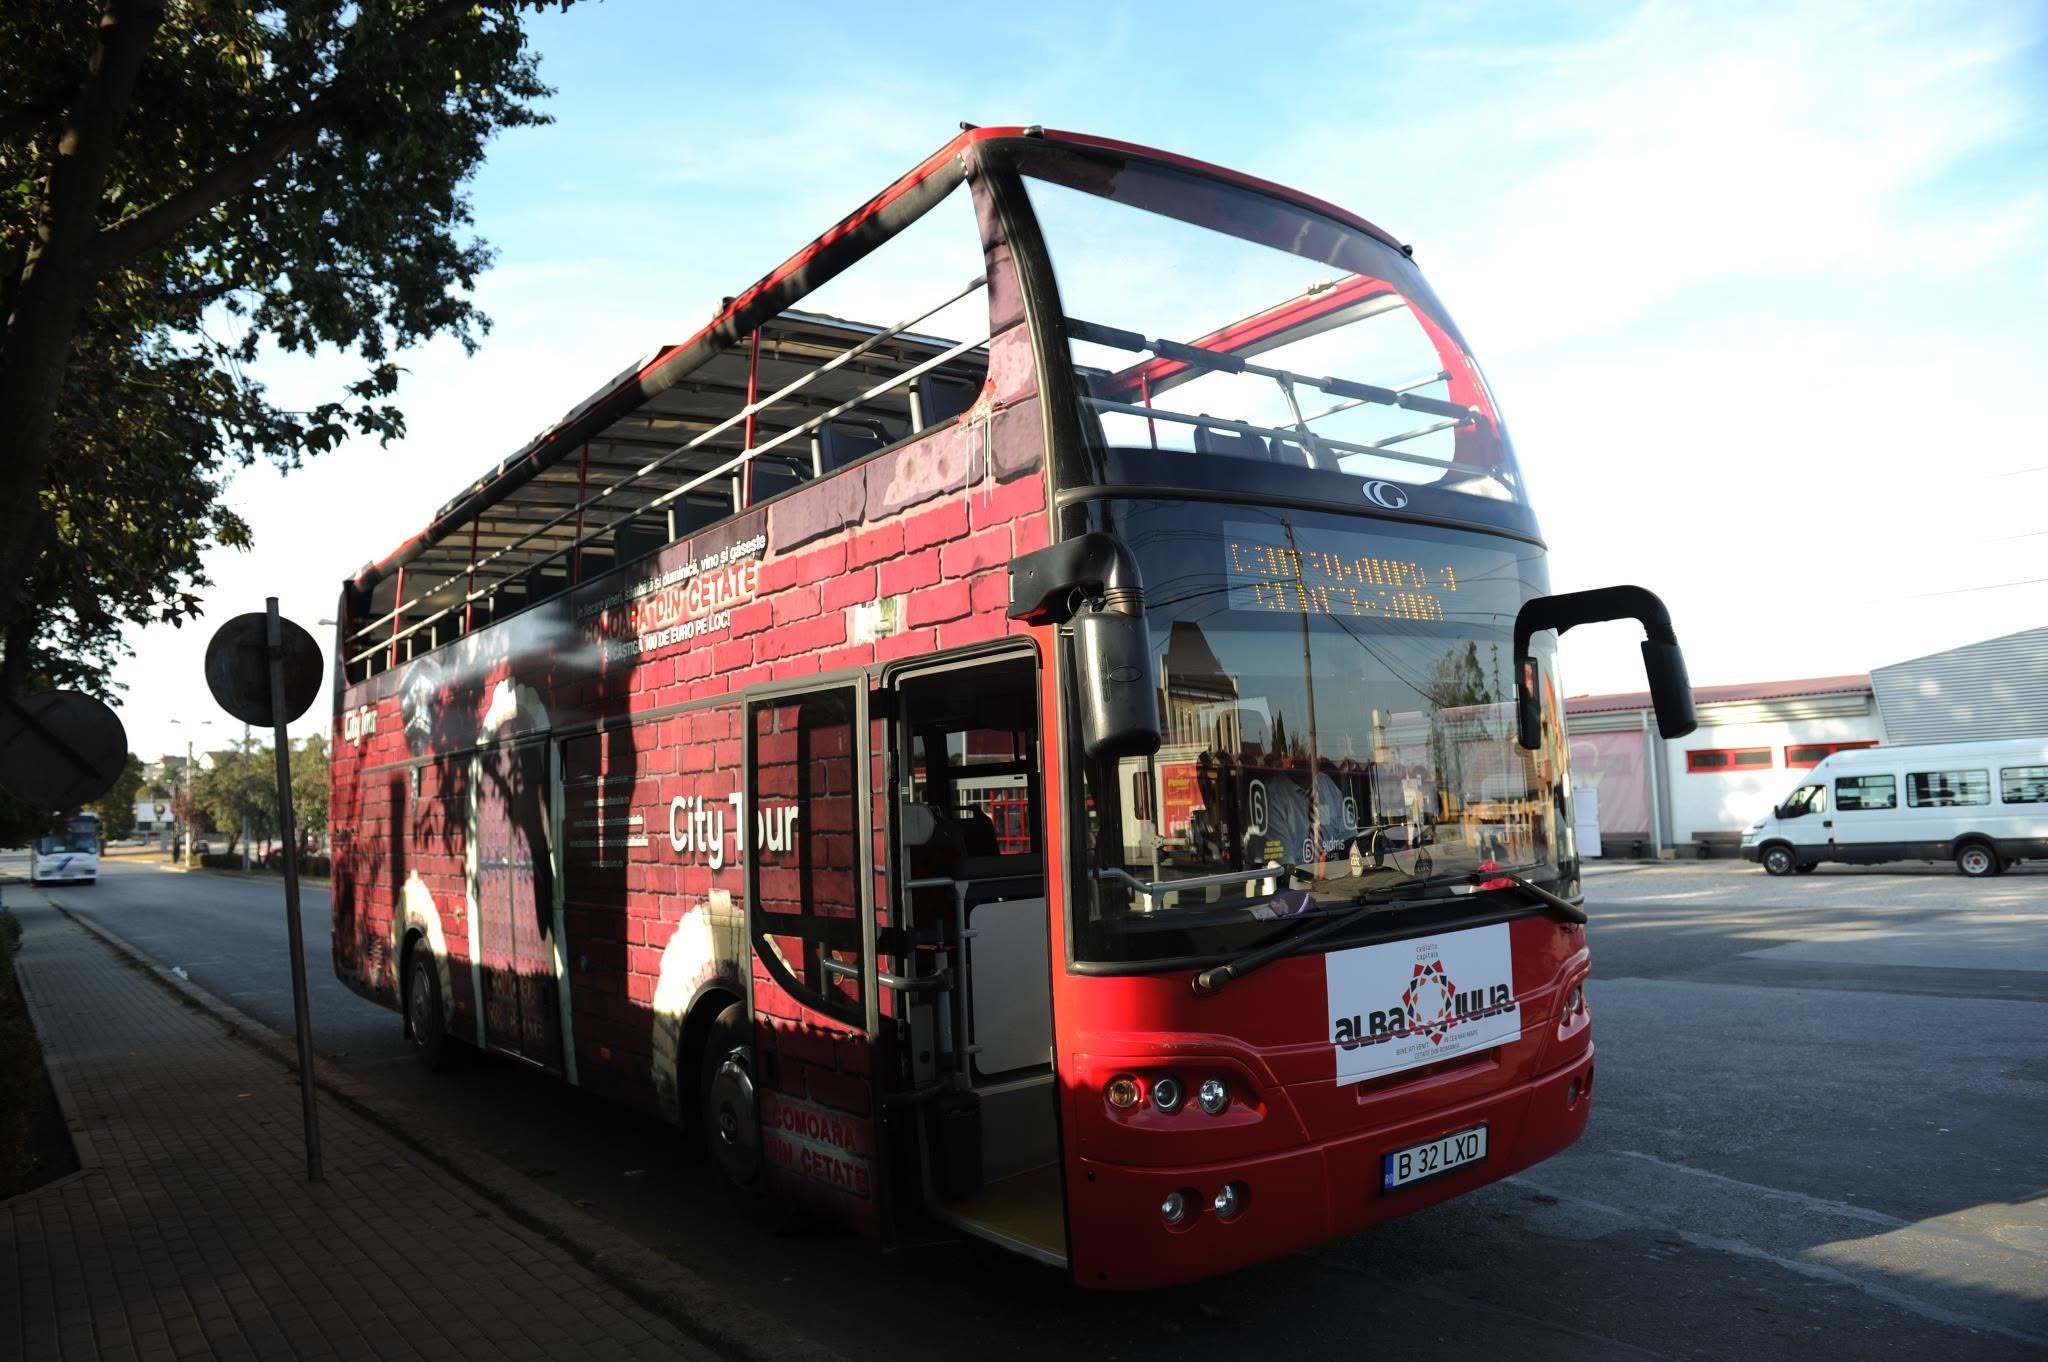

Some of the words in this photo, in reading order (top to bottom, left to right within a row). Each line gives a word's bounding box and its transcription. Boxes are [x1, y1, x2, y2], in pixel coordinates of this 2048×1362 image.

[700, 554, 719, 571] vino
[656, 588, 680, 622] DIN
[688, 559, 758, 612] CETATE
[658, 631, 670, 648] DE
[671, 623, 694, 643] EURO
[695, 619, 708, 637] PE
[708, 611, 731, 633] LOC!
[669, 794, 724, 870] City
[1398, 1153, 1412, 1180] B
[1418, 1144, 1439, 1174] 32
[1444, 1133, 1479, 1166] LXD
